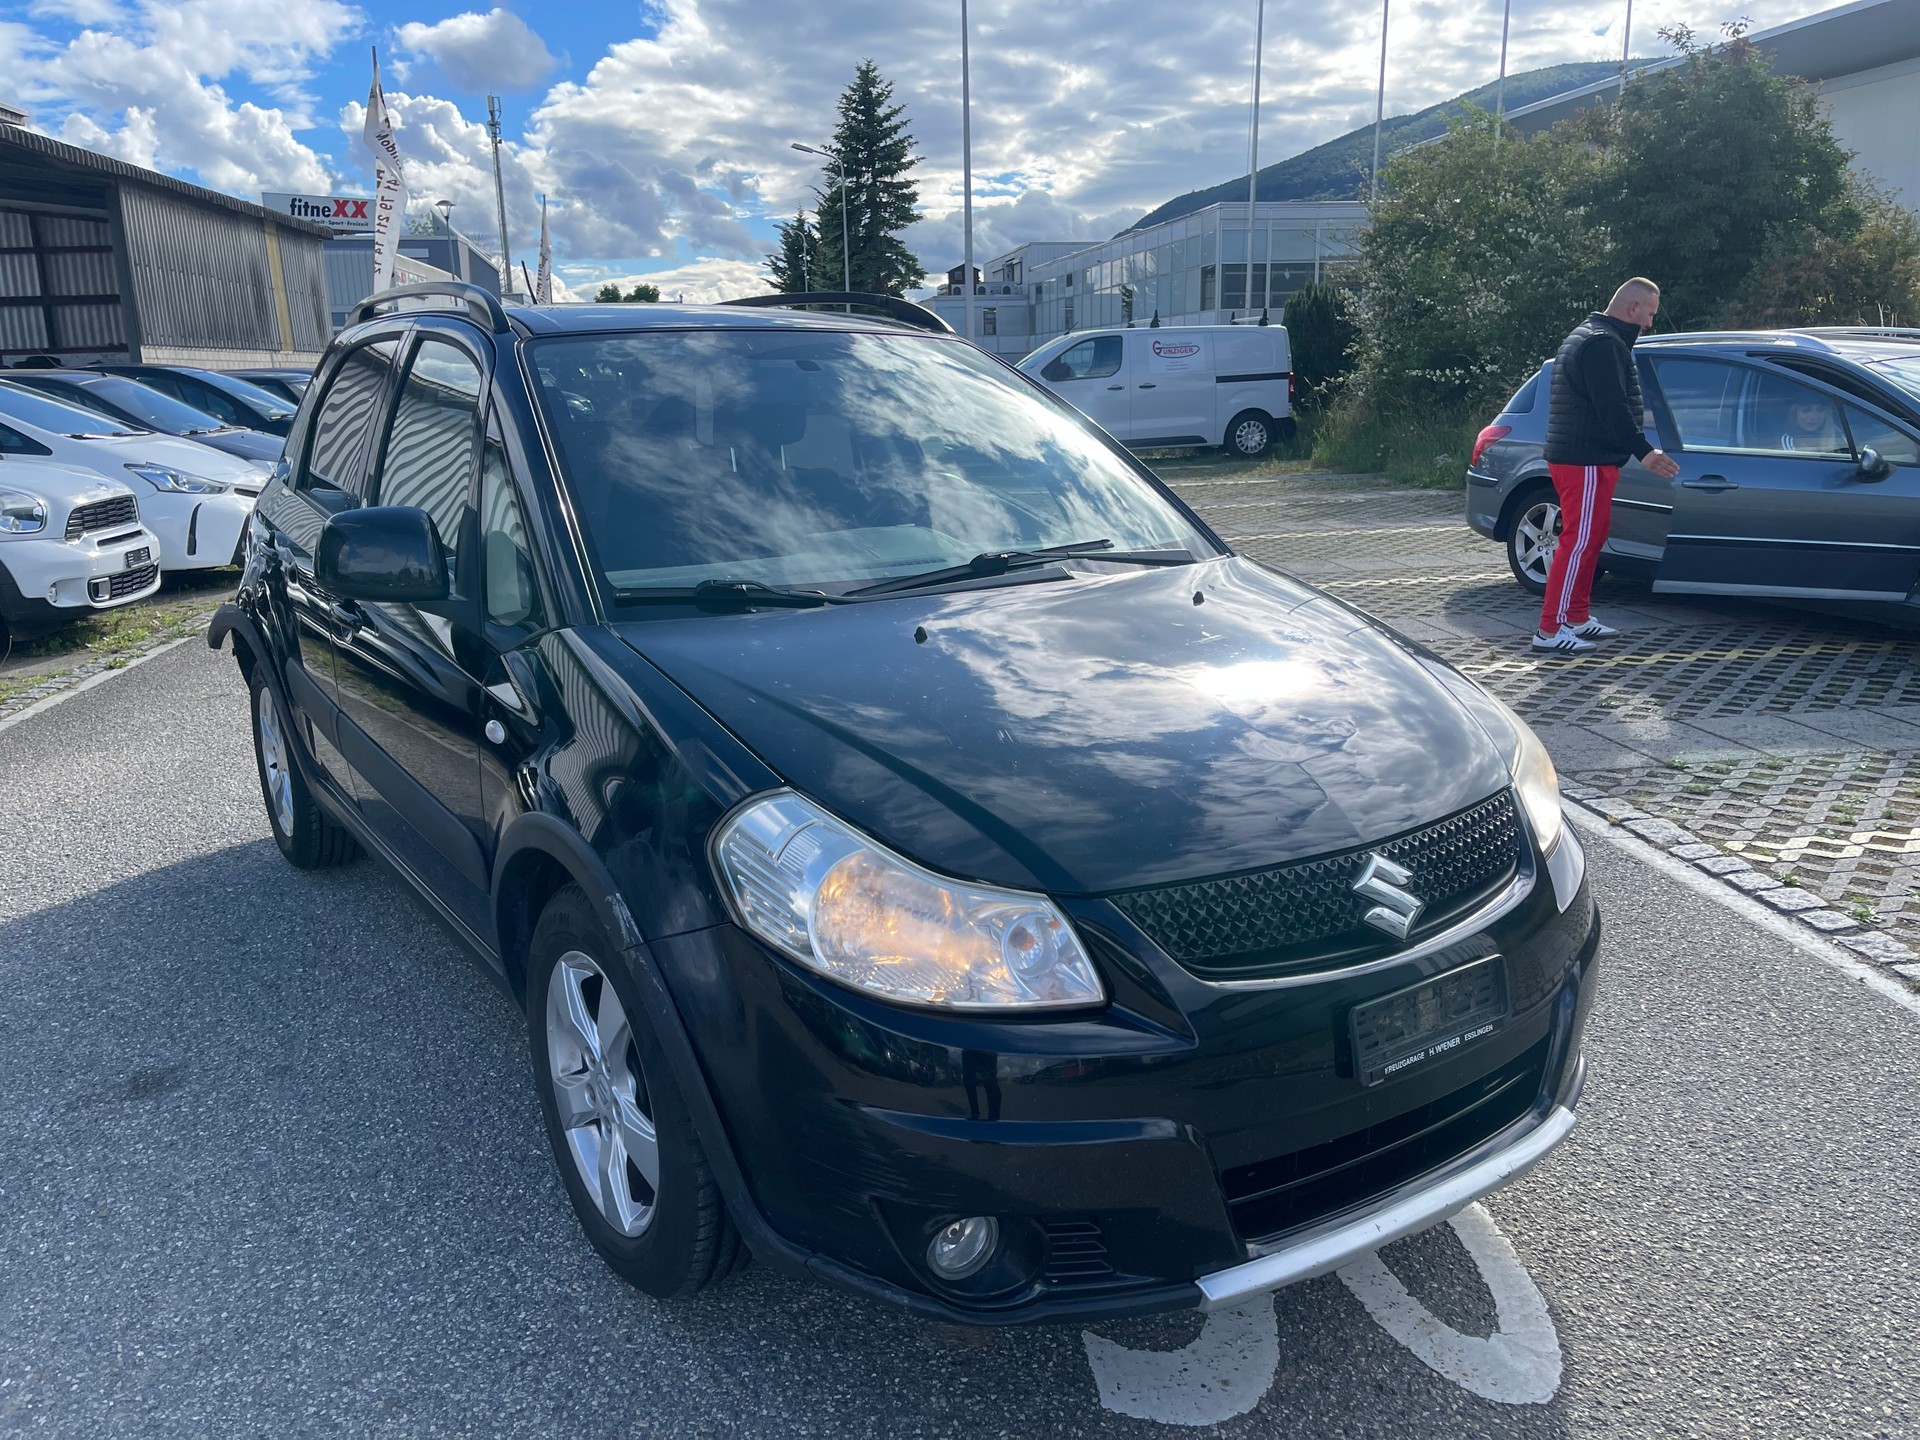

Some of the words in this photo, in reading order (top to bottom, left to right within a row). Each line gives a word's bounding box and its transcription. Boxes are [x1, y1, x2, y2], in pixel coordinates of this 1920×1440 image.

[290, 197, 368, 219] fitneXX
[1384, 1051, 1425, 1075] KREUZGARAGE
[1464, 1024, 1494, 1042] ESSLINGEN
